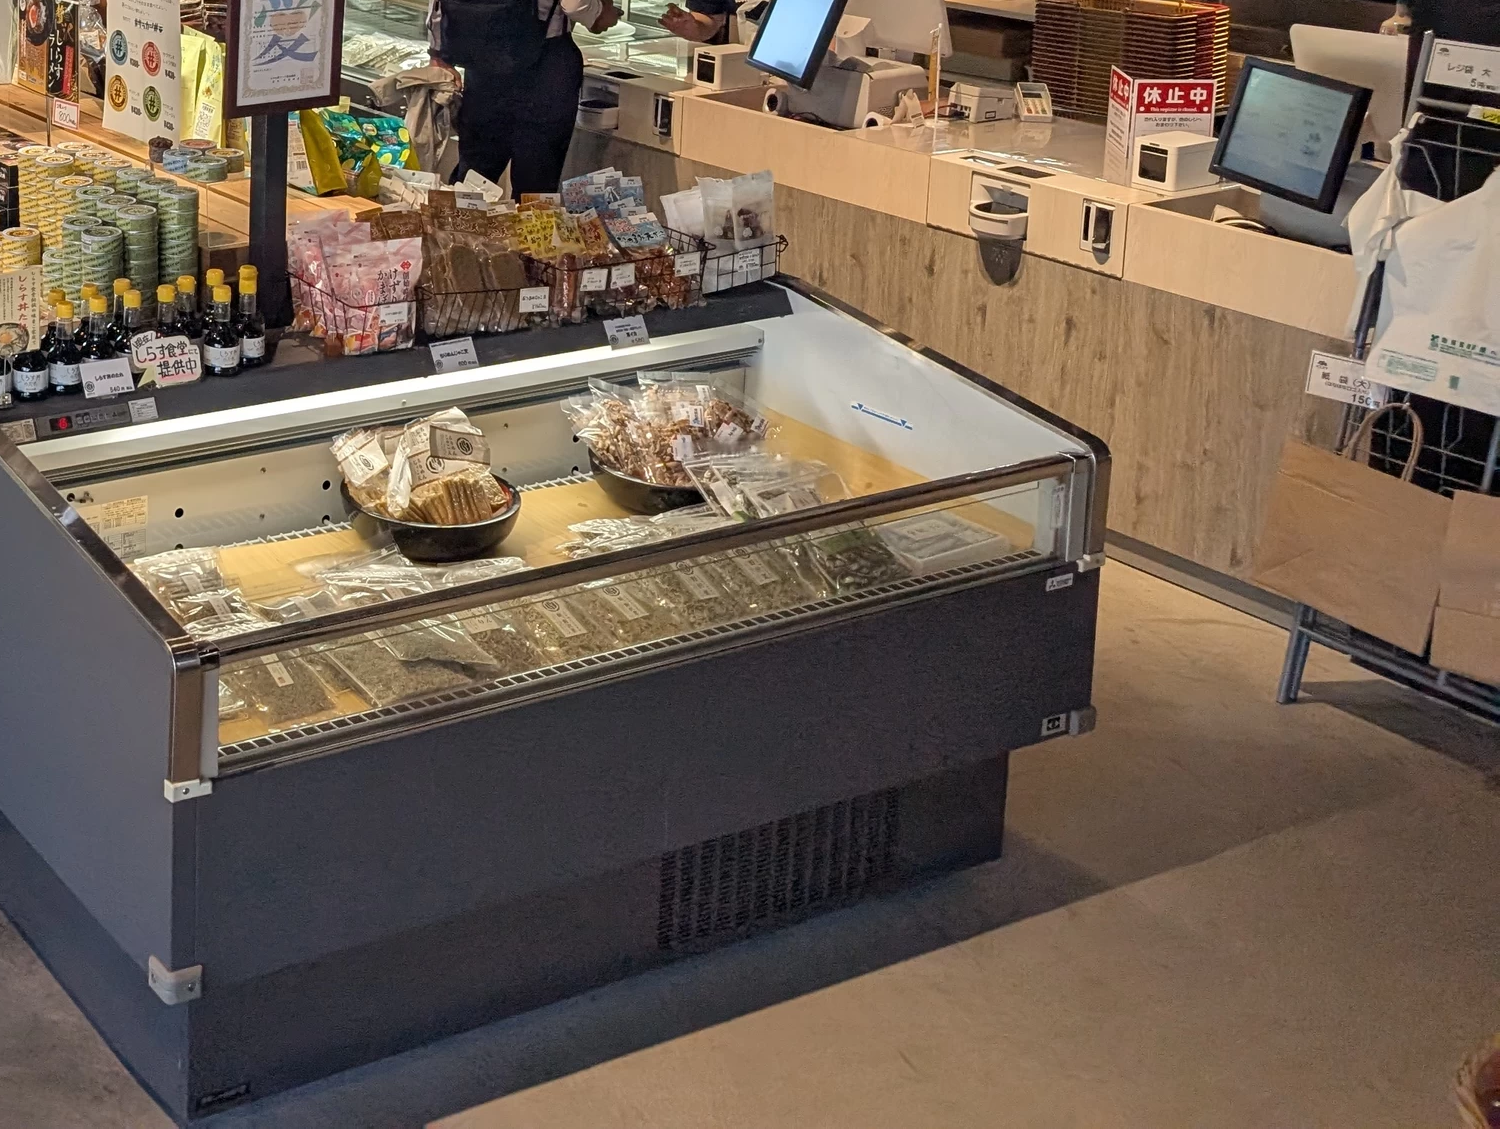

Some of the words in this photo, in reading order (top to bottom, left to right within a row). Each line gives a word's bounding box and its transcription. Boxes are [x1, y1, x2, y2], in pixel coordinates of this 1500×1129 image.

[55, 29, 63, 80] しらす
[1447, 62, 1474, 74] レジ袋
[1482, 67, 1491, 76] 大
[1143, 86, 1208, 105] 休止中
[135, 340, 199, 364] しらす食堂にて
[157, 358, 197, 379] 提供中
[1322, 371, 1330, 380] 紙
[1339, 375, 1348, 384] 袋
